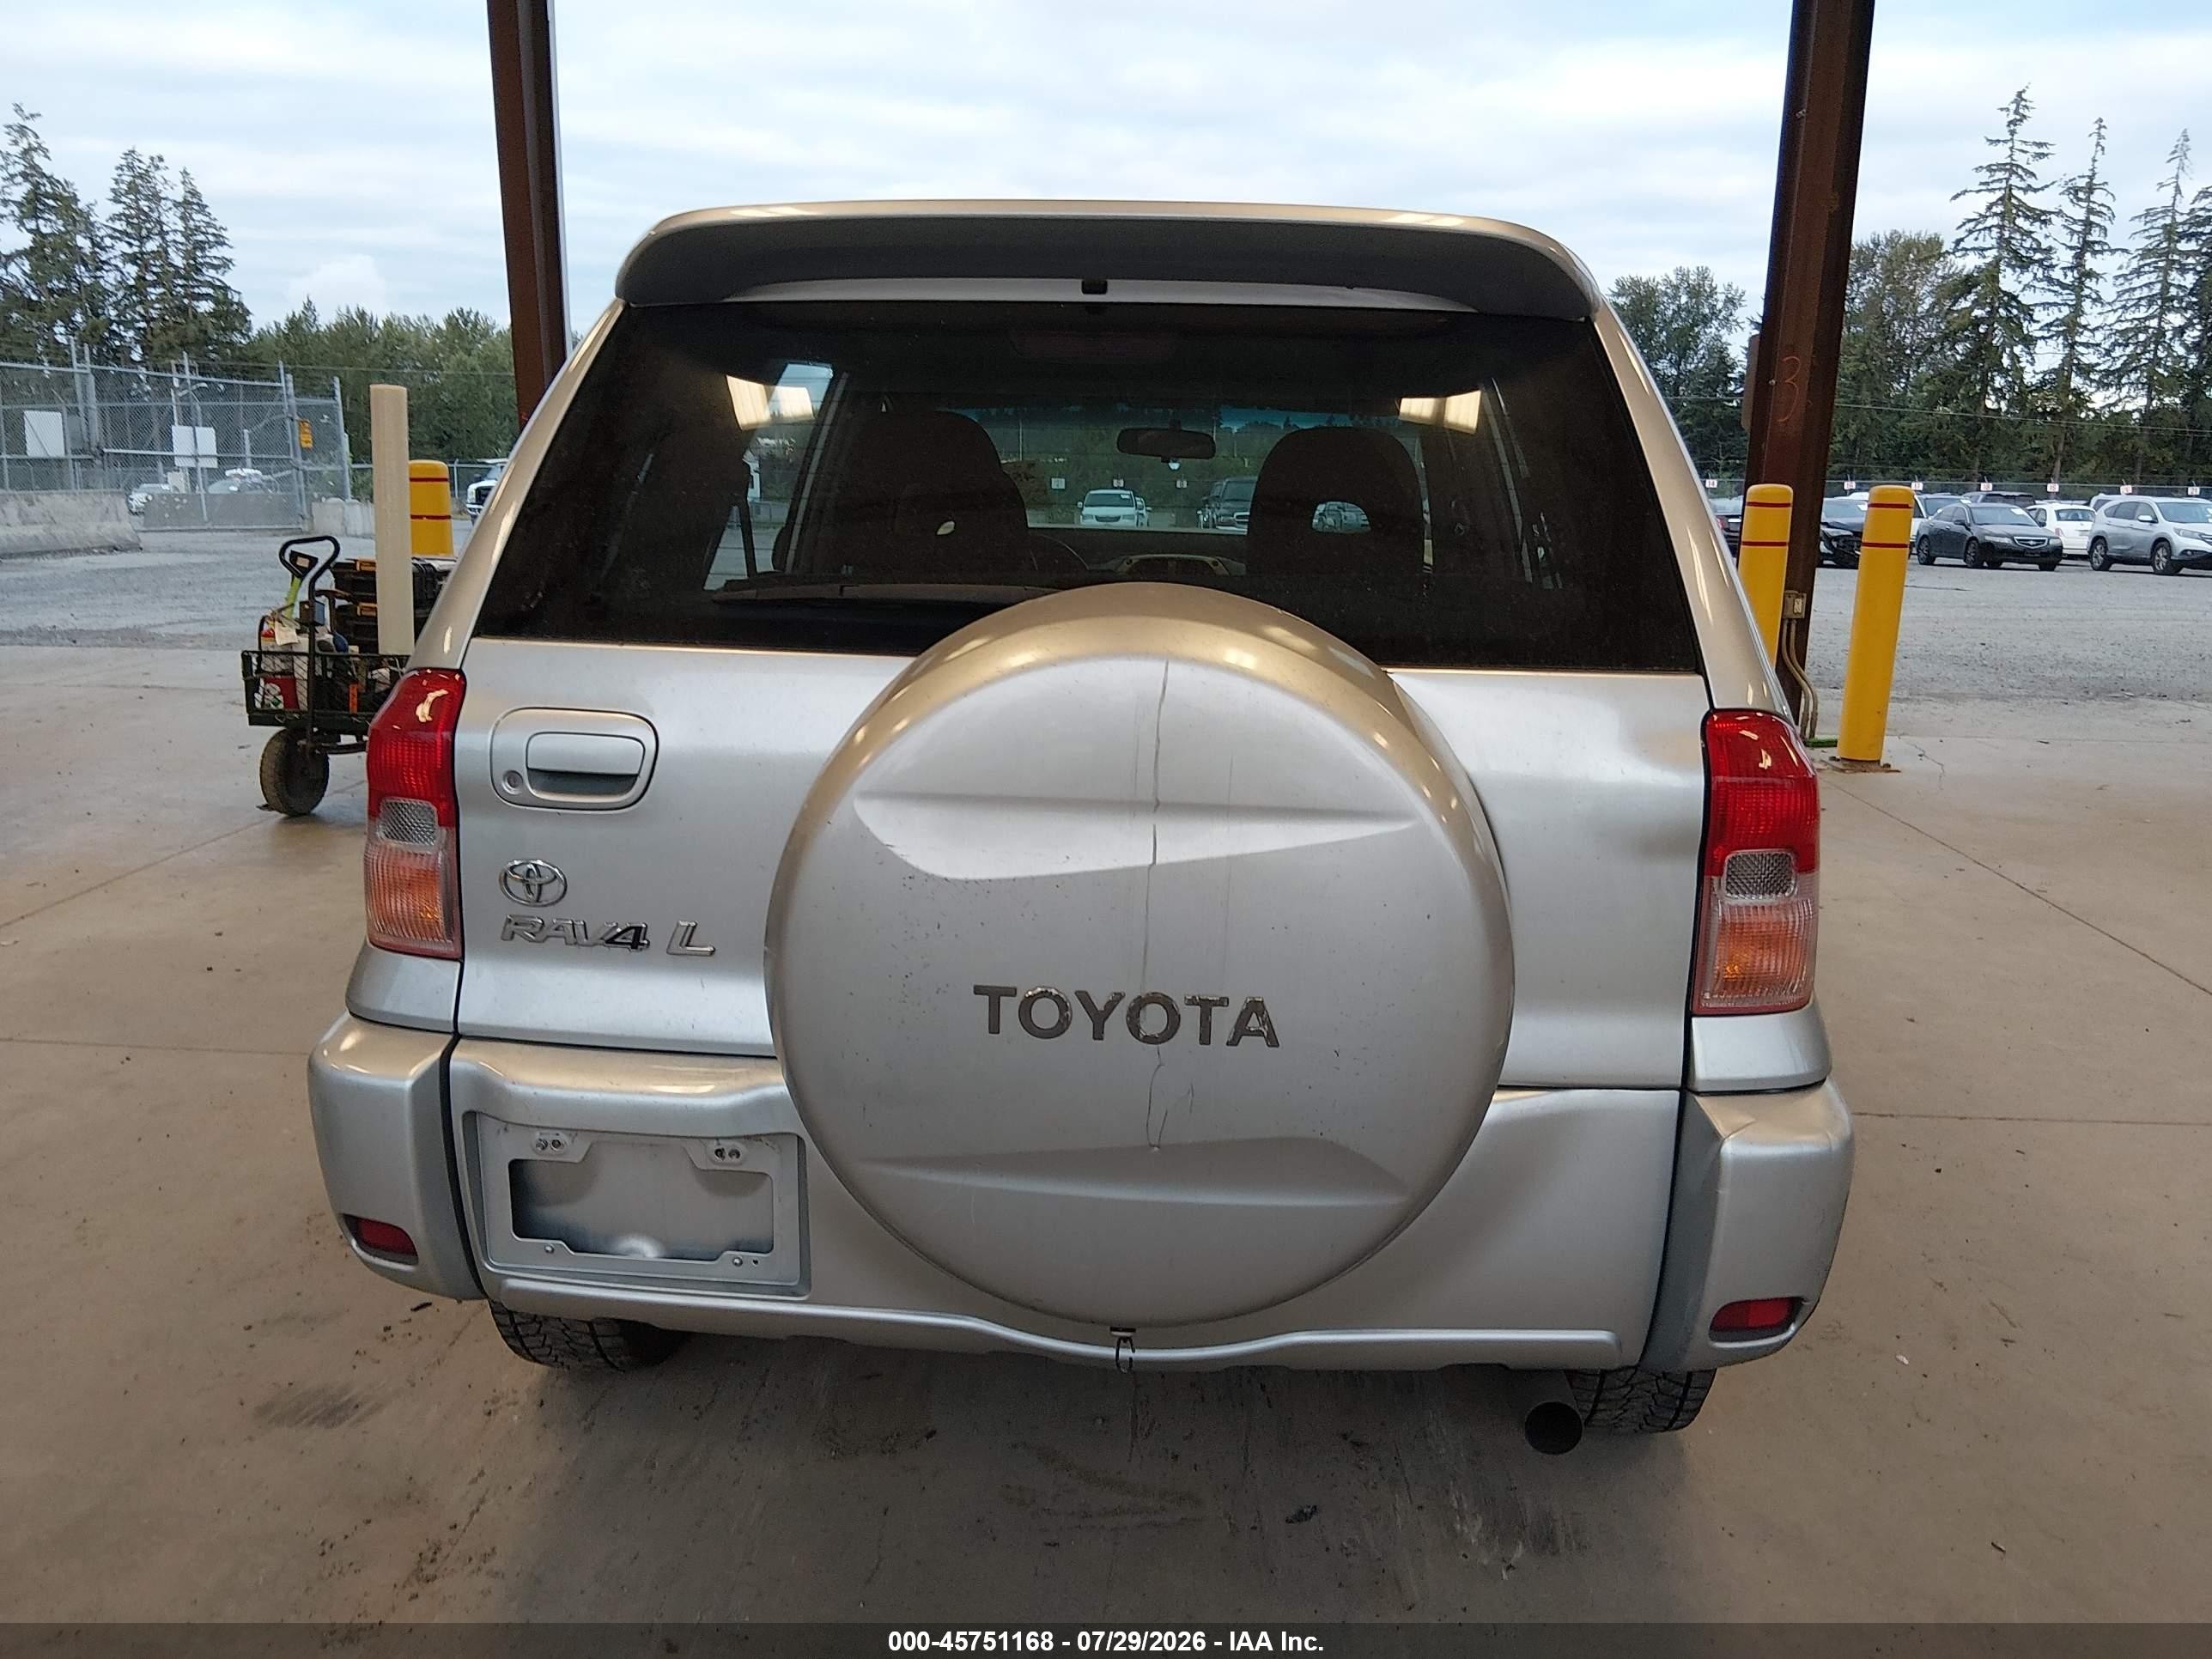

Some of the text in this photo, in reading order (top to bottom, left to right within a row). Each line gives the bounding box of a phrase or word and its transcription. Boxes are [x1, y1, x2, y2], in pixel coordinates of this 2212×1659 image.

[1777, 356, 1801, 422] 3
[501, 915, 715, 956] RAV4 L
[973, 984, 1279, 1048] TOYOTA
